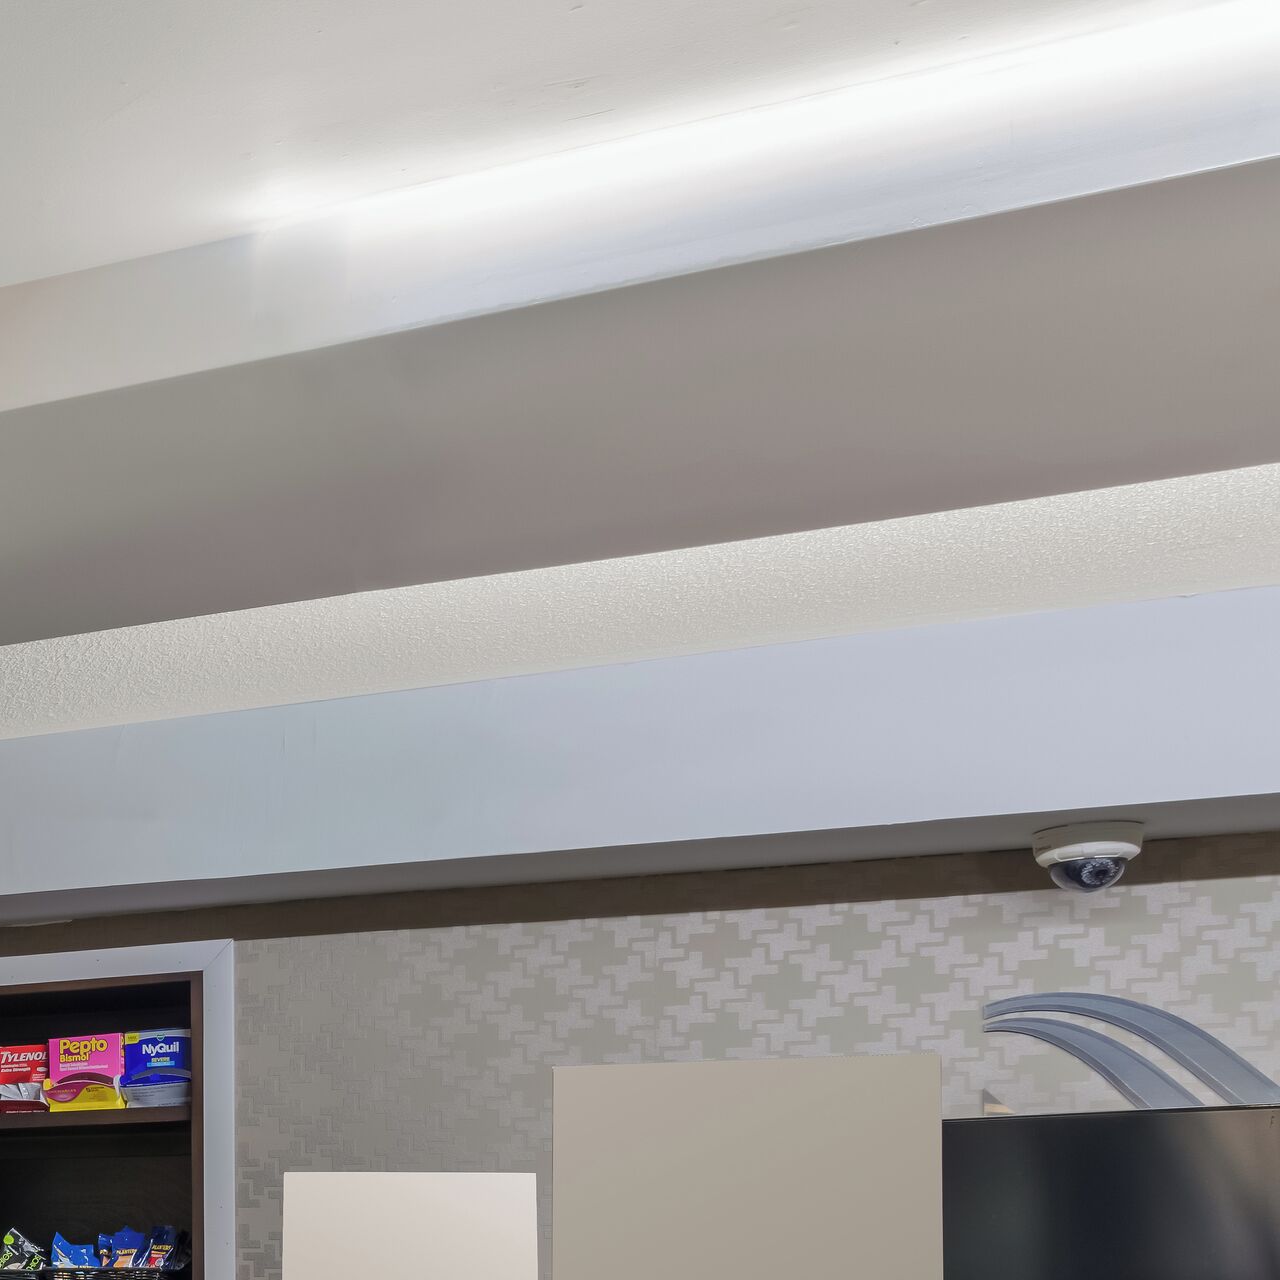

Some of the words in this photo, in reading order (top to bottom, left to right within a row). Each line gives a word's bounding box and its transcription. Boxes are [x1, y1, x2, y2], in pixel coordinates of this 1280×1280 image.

[59, 1037, 108, 1055] Pepto
[142, 1041, 180, 1056] NyQuil
[0, 1052, 48, 1064] TYLENOL
[59, 1053, 89, 1062] Bismol
